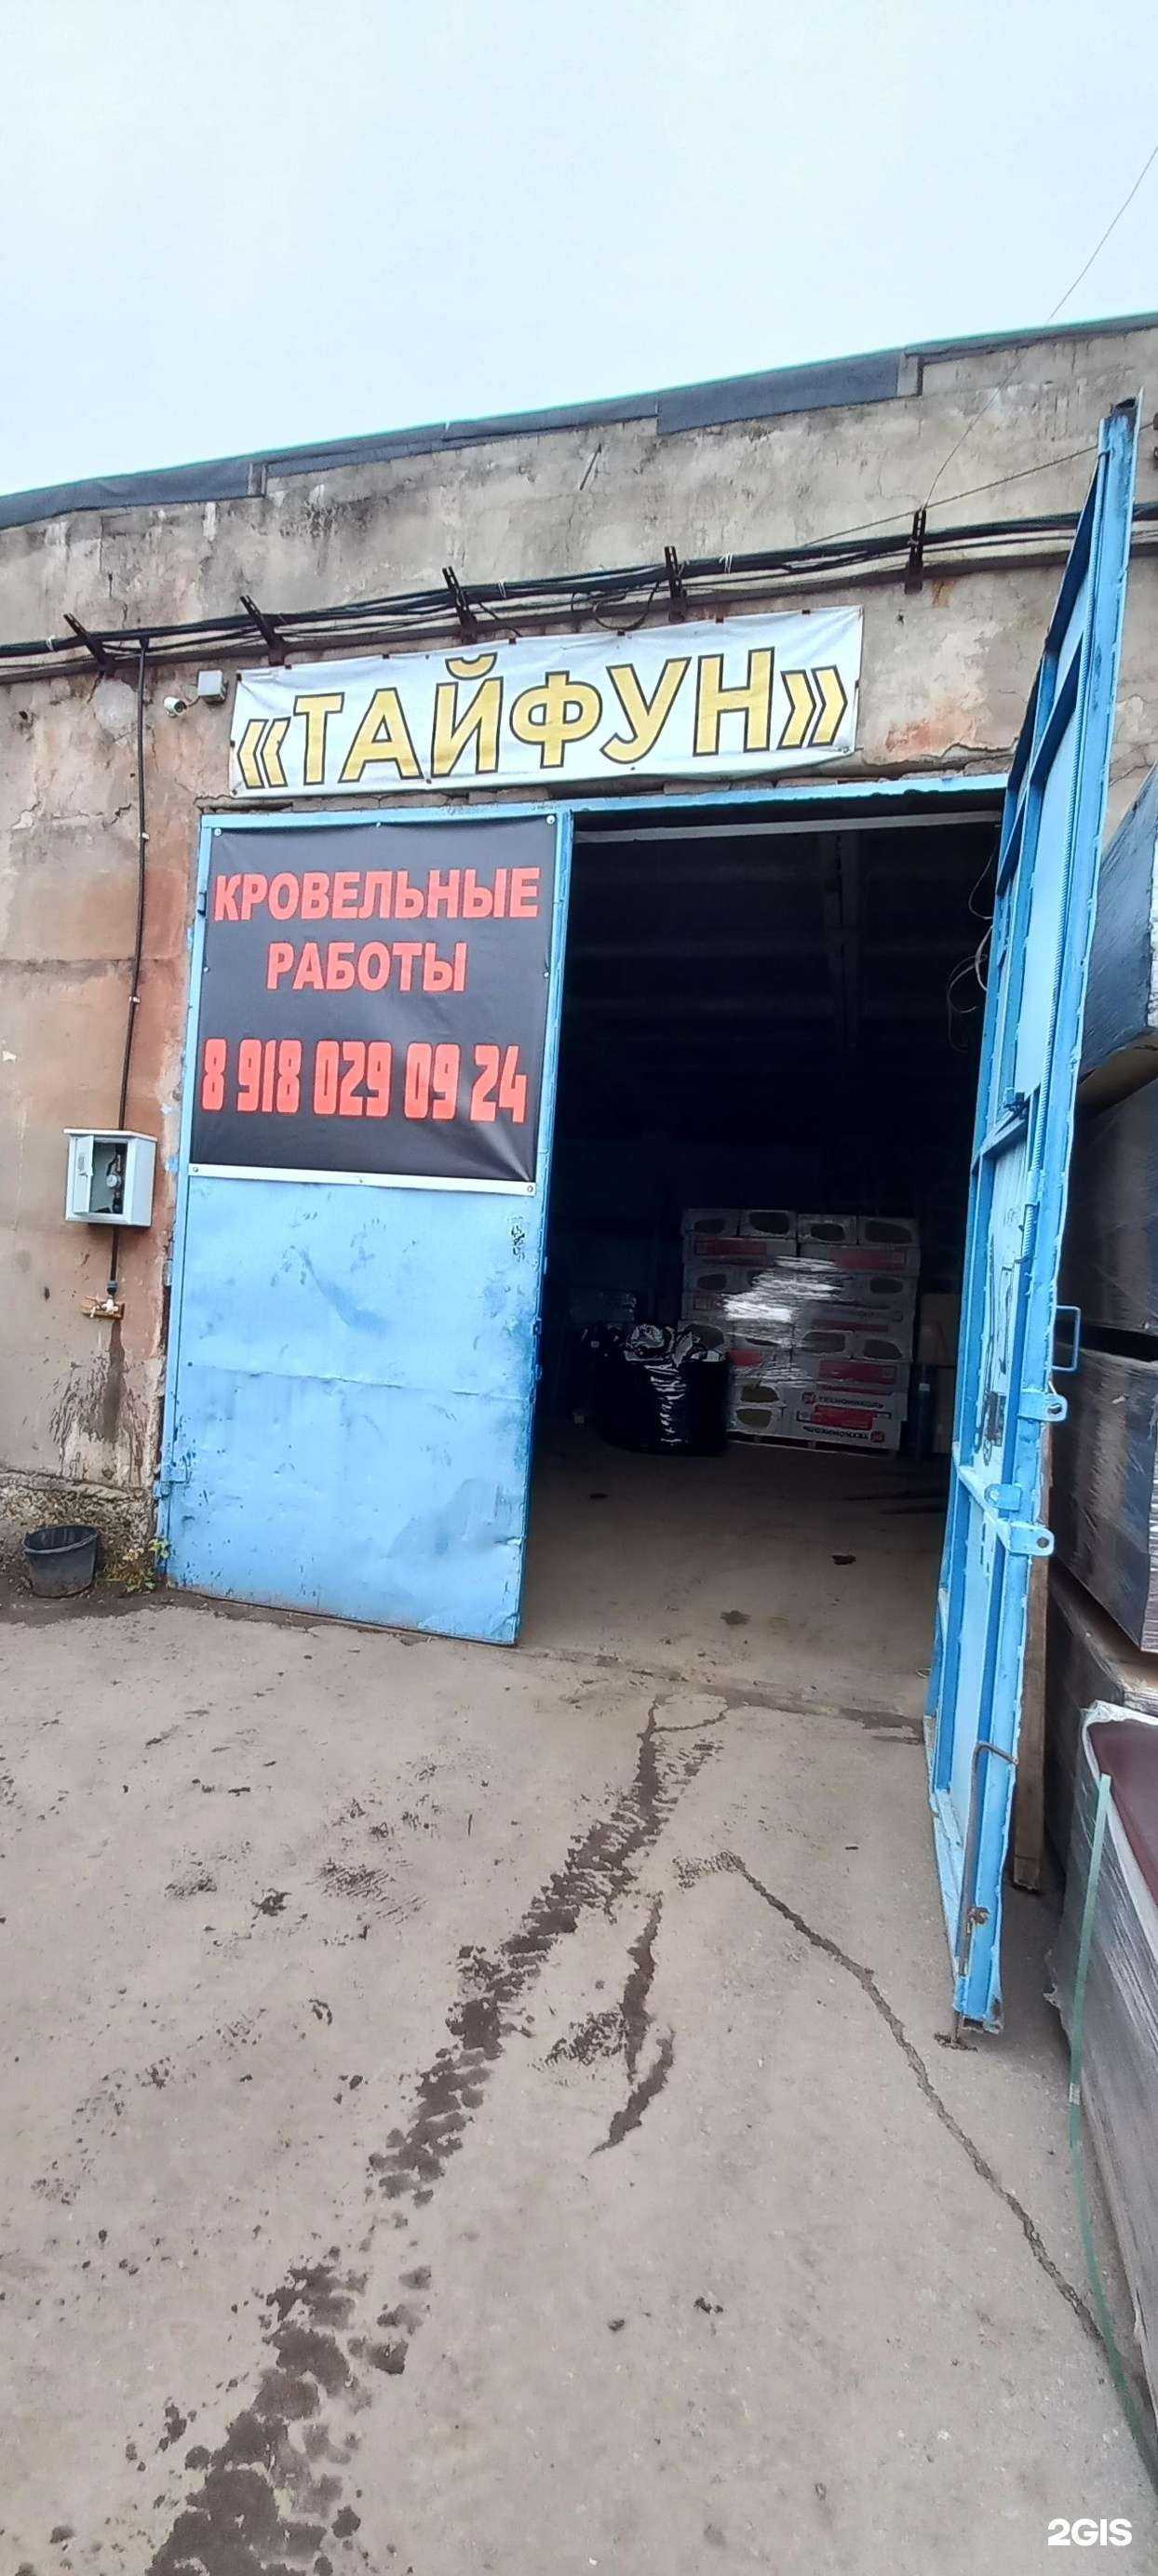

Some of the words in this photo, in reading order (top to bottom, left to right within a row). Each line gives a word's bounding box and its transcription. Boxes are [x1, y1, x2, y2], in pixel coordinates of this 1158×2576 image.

[236, 646, 849, 790] «ТАЙФУН»
[213, 866, 541, 921] КРОВЕЛЬНЫЕ
[265, 941, 468, 992] РАБОТЫ
[201, 1038, 228, 1111] 8
[236, 1039, 303, 1114] 918
[312, 1039, 393, 1119] 029
[403, 1041, 461, 1120] 09
[469, 1043, 529, 1124] 24
